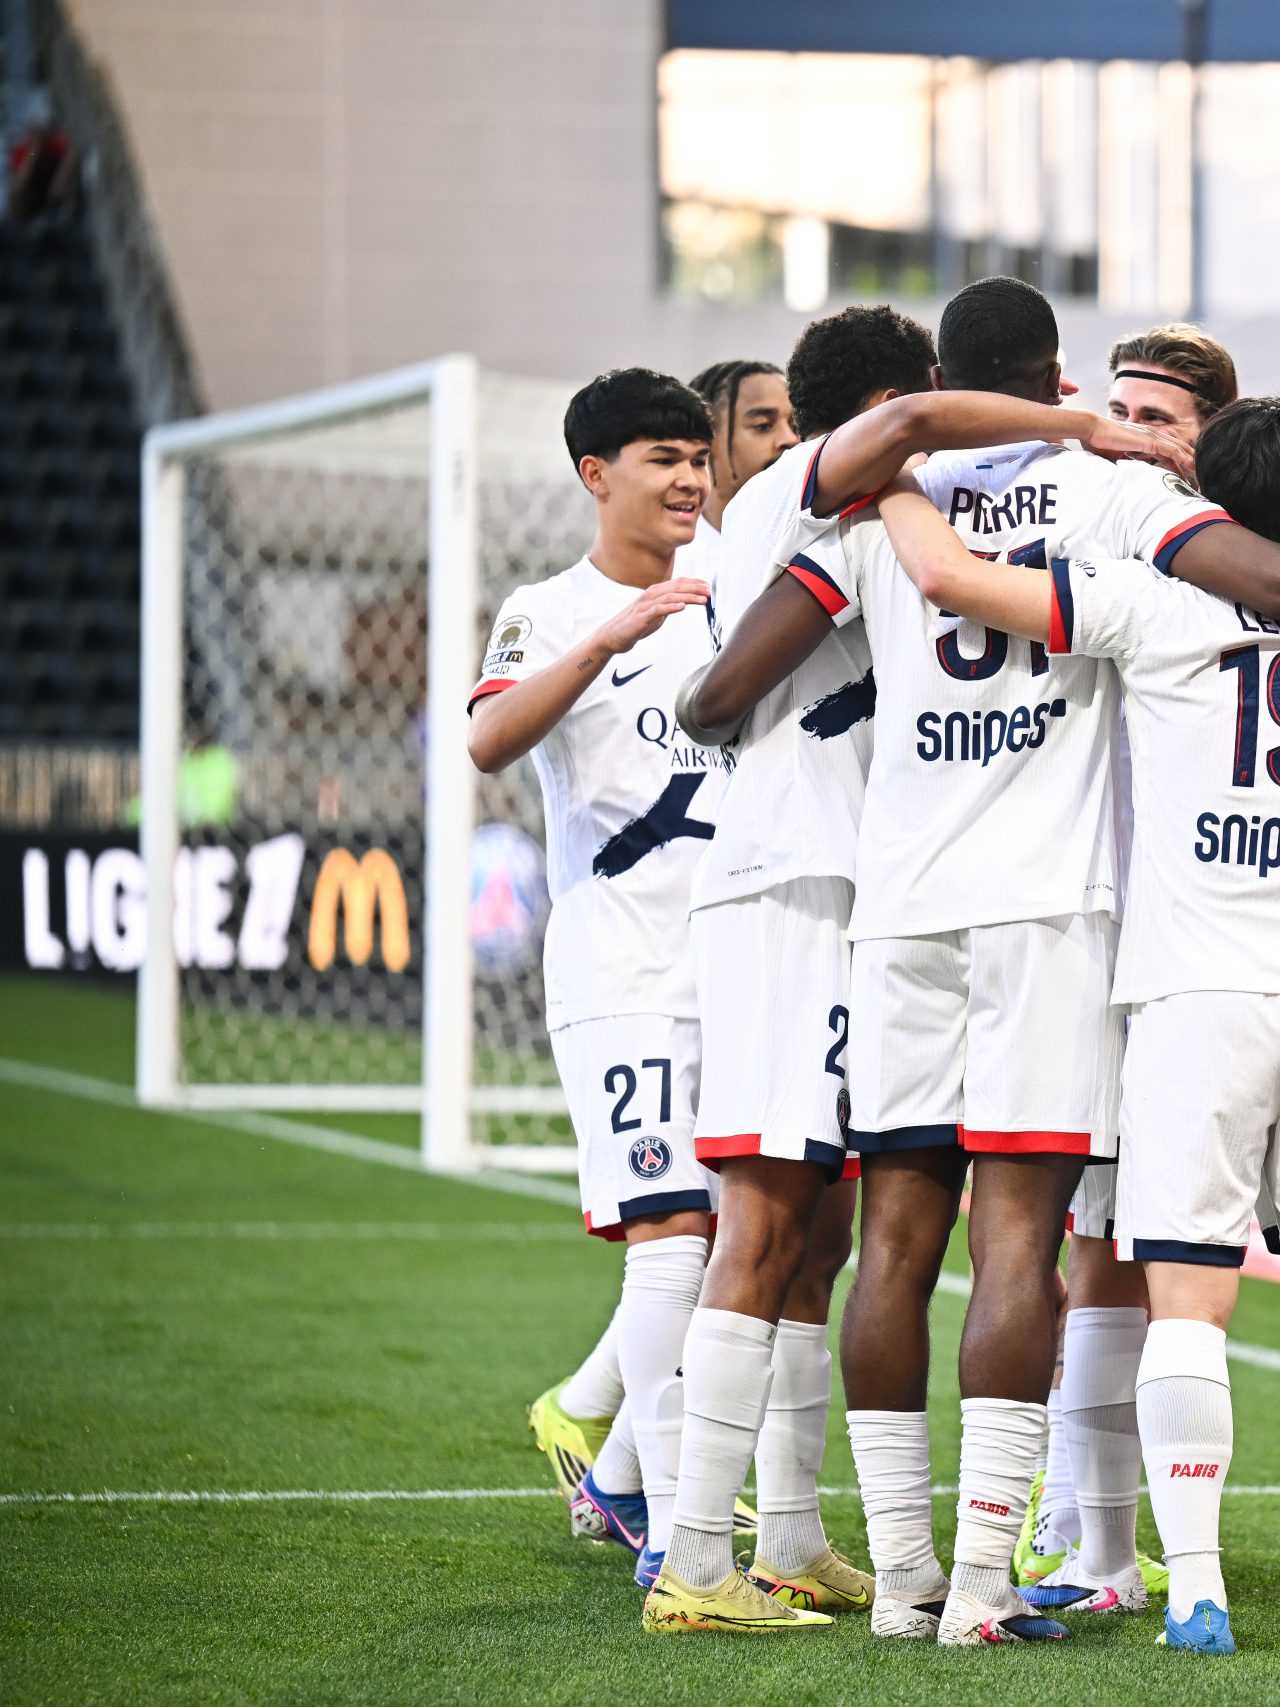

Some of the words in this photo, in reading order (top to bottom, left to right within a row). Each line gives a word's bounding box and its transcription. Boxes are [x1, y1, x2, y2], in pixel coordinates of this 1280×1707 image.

[604, 1058, 671, 1134] 27
[633, 1139, 662, 1154] PARIS
[1170, 1463, 1220, 1479] PARIS
[968, 1499, 1011, 1517] PARIS
